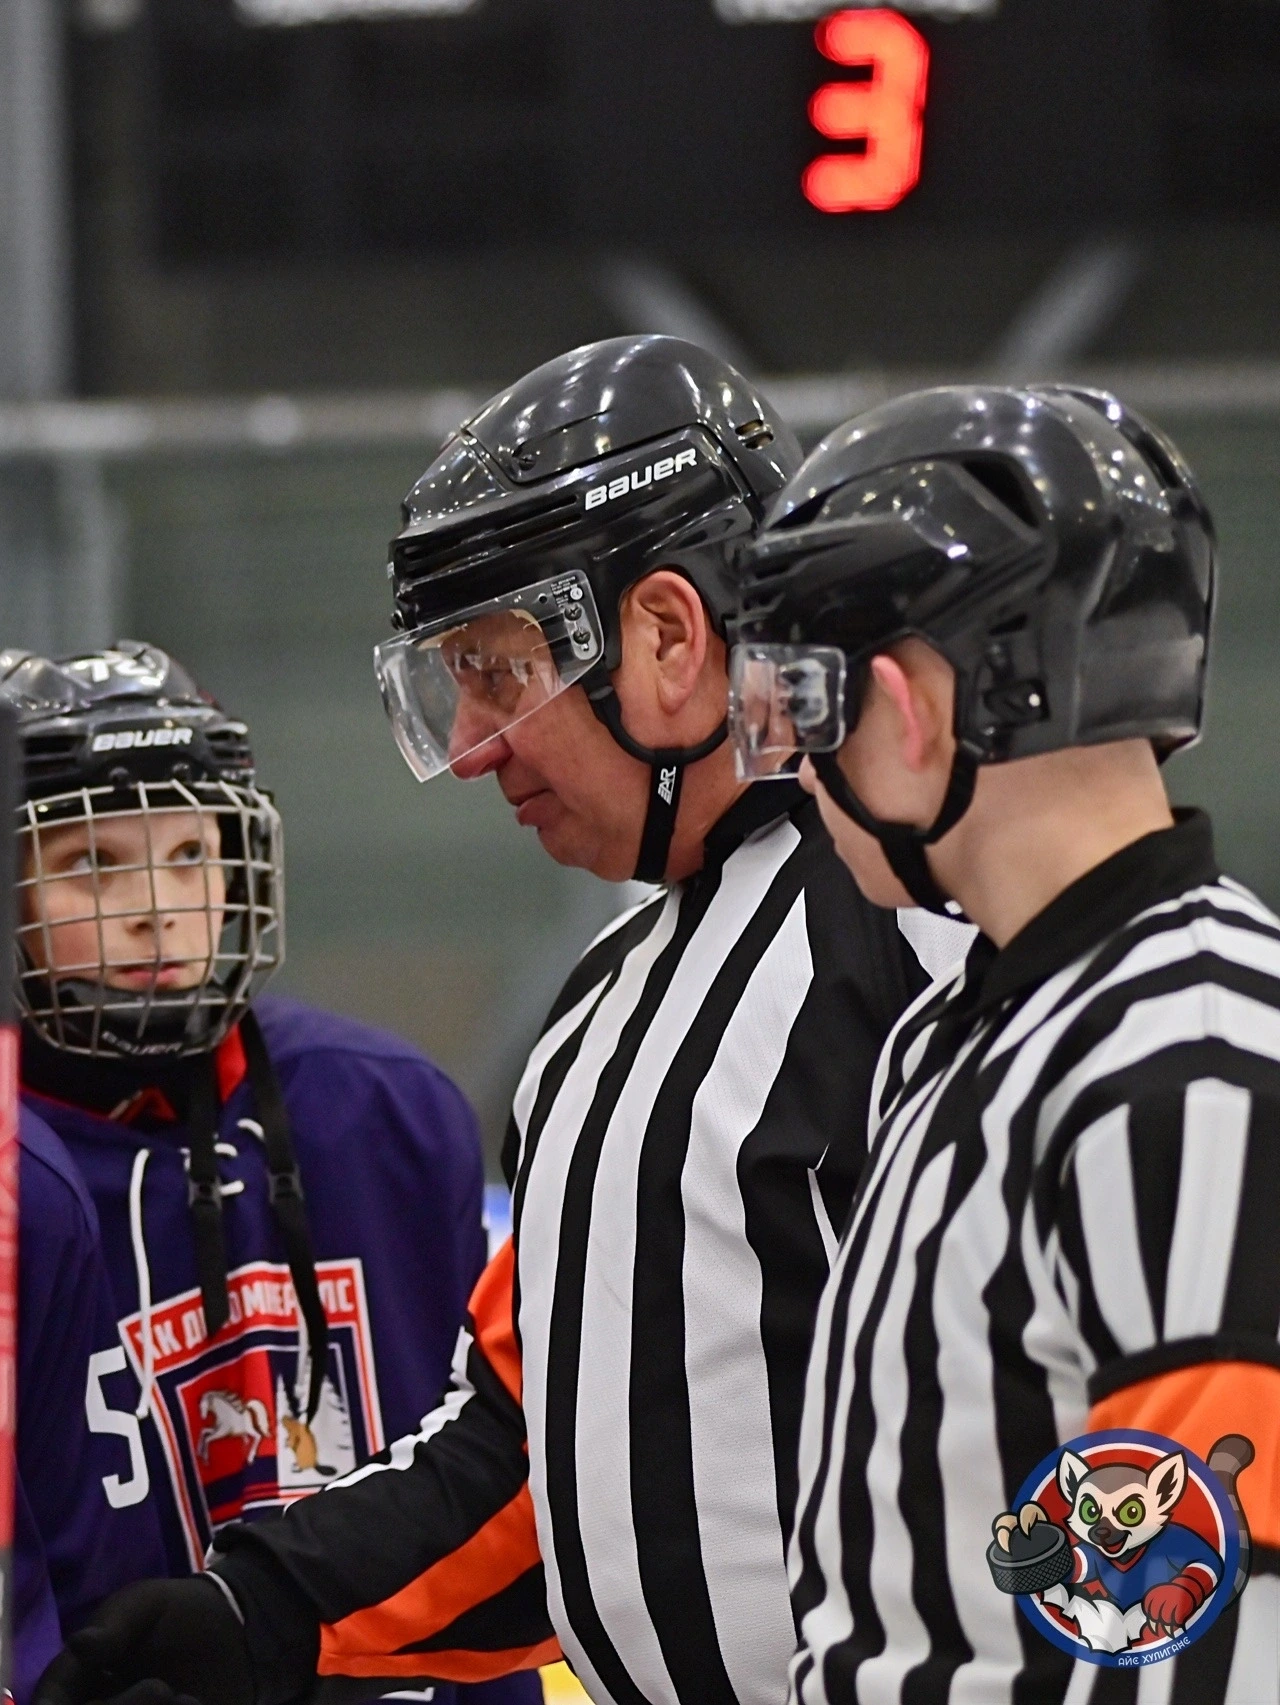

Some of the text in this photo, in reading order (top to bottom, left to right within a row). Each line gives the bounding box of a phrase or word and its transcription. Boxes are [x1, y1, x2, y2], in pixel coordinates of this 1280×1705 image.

[801, 8, 930, 213] 3
[585, 448, 697, 511] BAUER
[91, 727, 194, 752] BAUER
